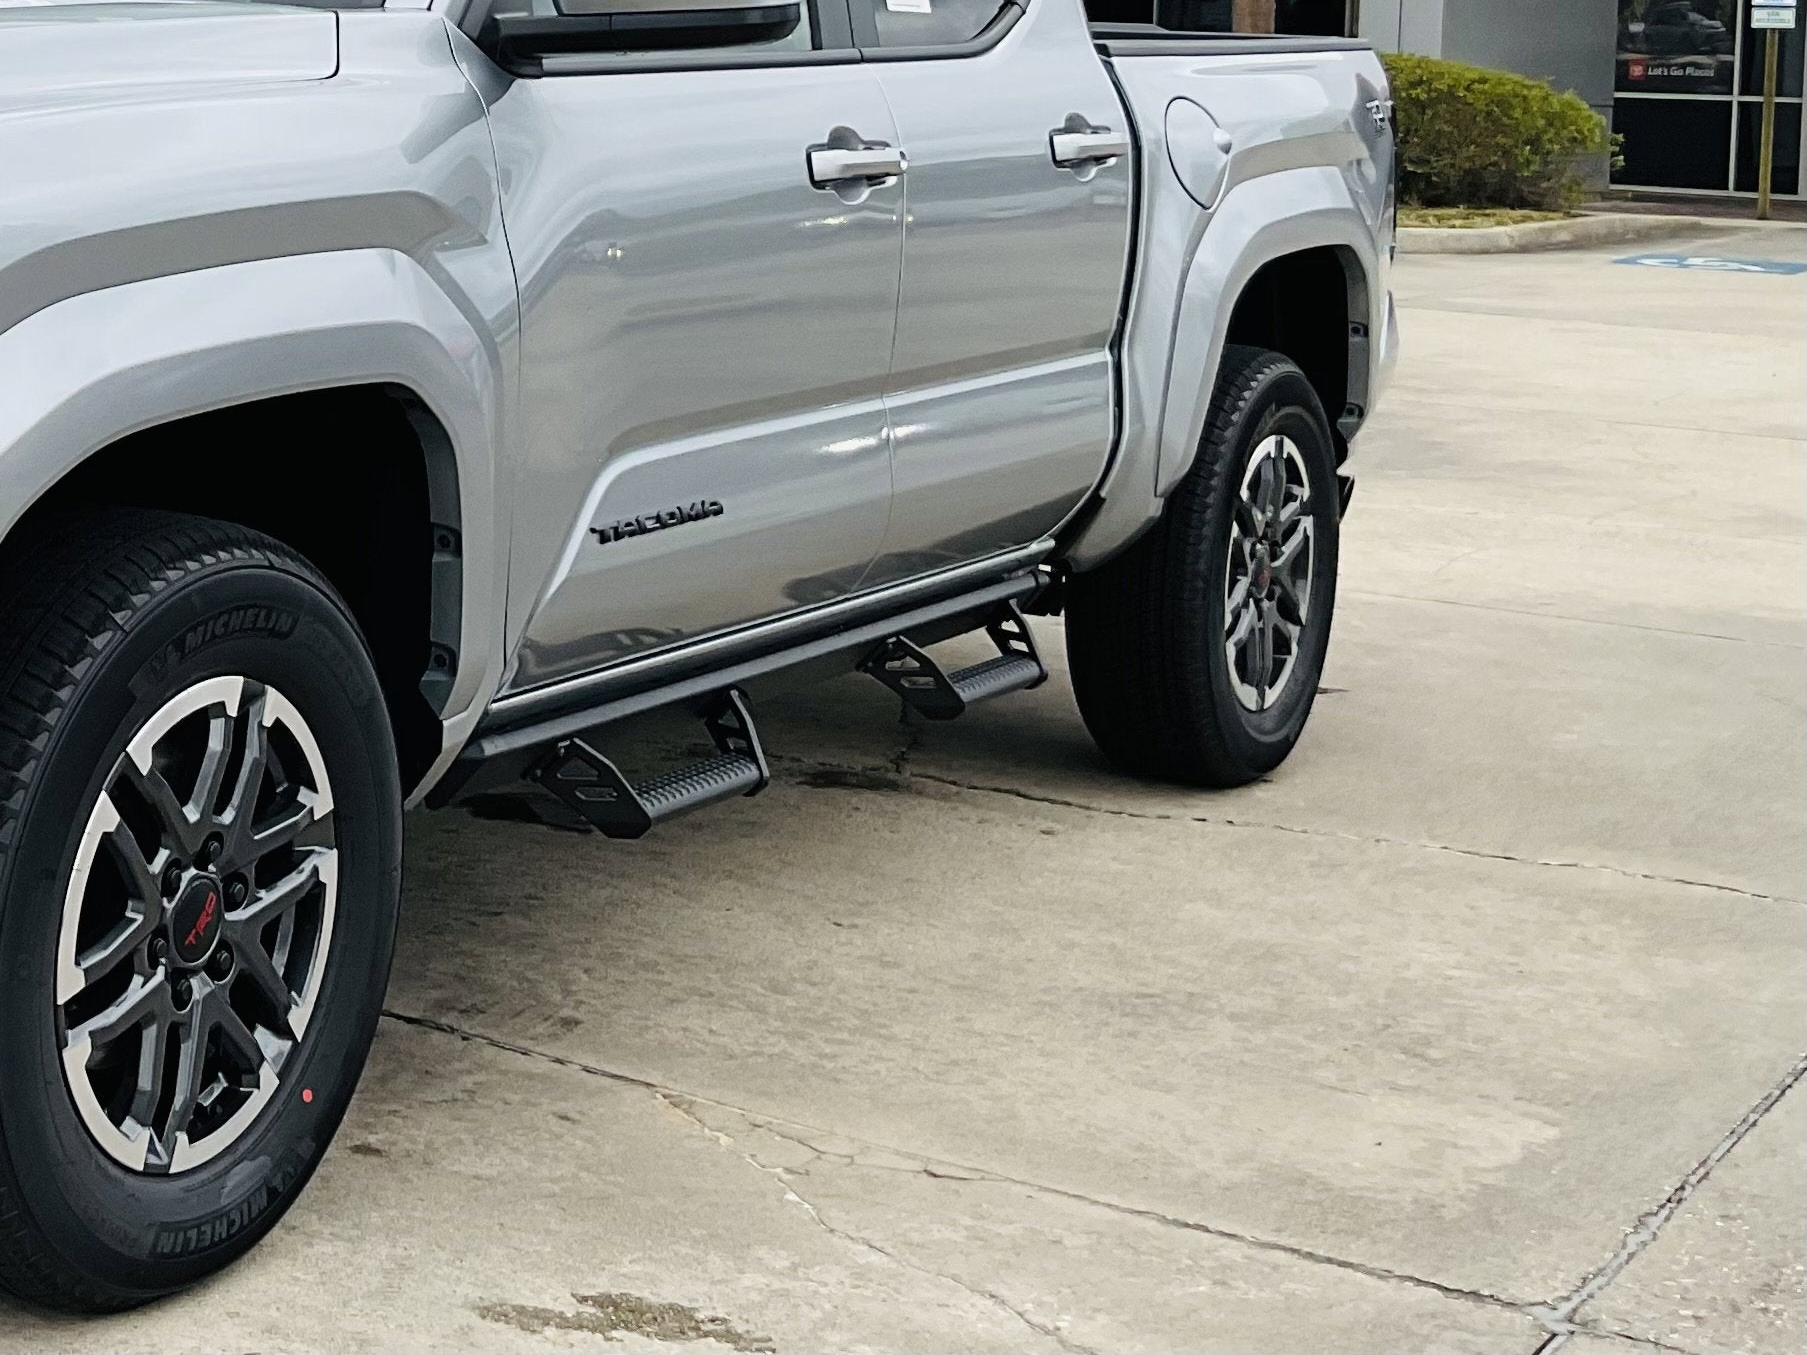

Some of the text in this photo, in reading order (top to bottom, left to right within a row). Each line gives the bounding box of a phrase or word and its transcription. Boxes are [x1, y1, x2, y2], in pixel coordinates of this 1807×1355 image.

[1670, 66, 1684, 76] Go
[184, 606, 293, 655] MICHELIN
[155, 1182, 269, 1254] MICHELIN
